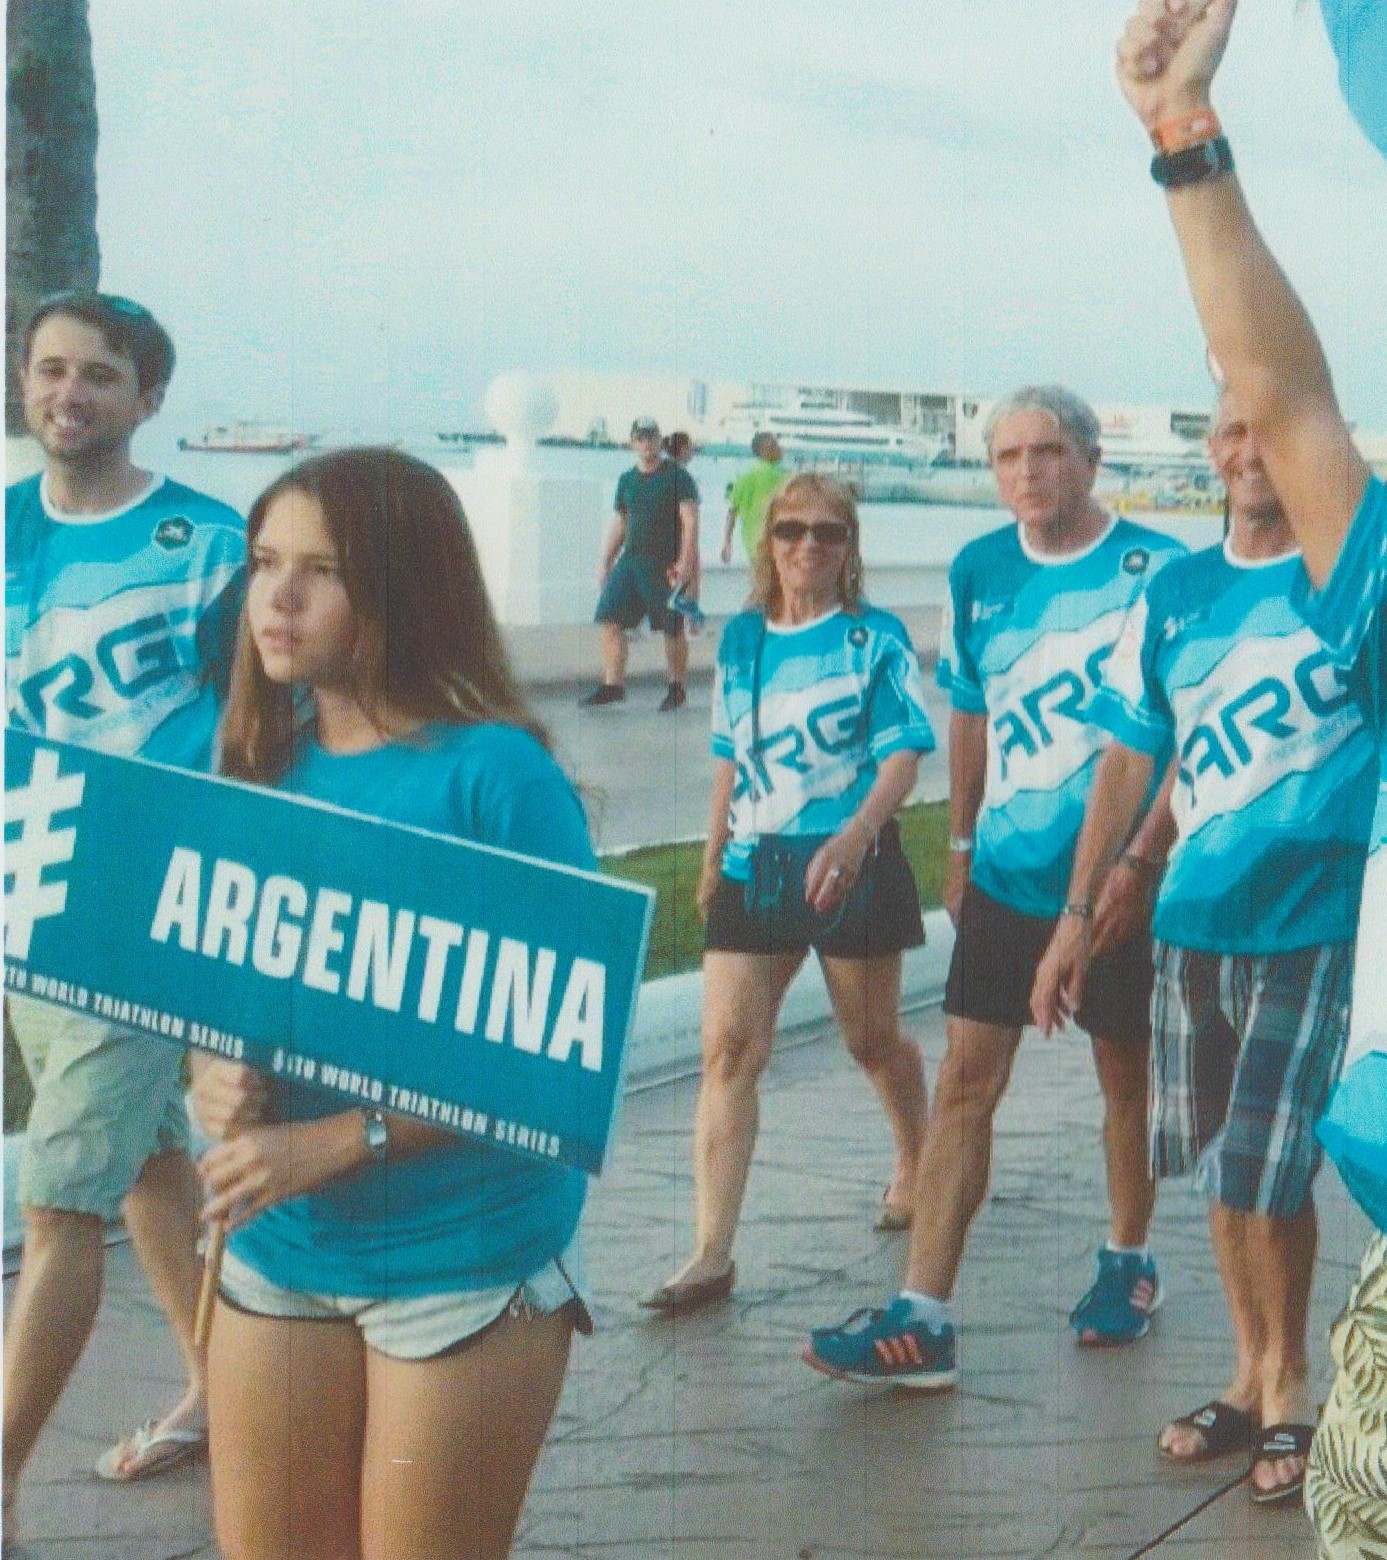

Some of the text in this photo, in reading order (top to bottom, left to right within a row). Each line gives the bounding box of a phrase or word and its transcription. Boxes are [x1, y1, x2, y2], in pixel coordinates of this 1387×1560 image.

[149, 846, 607, 1073] ARGENTINA
[32, 973, 88, 1009] WORLD
[94, 992, 185, 1039] TRIATHLON
[189, 1022, 244, 1059] SERIES
[286, 1053, 560, 1158] ITU WORLD TRIATHLON SERIES
